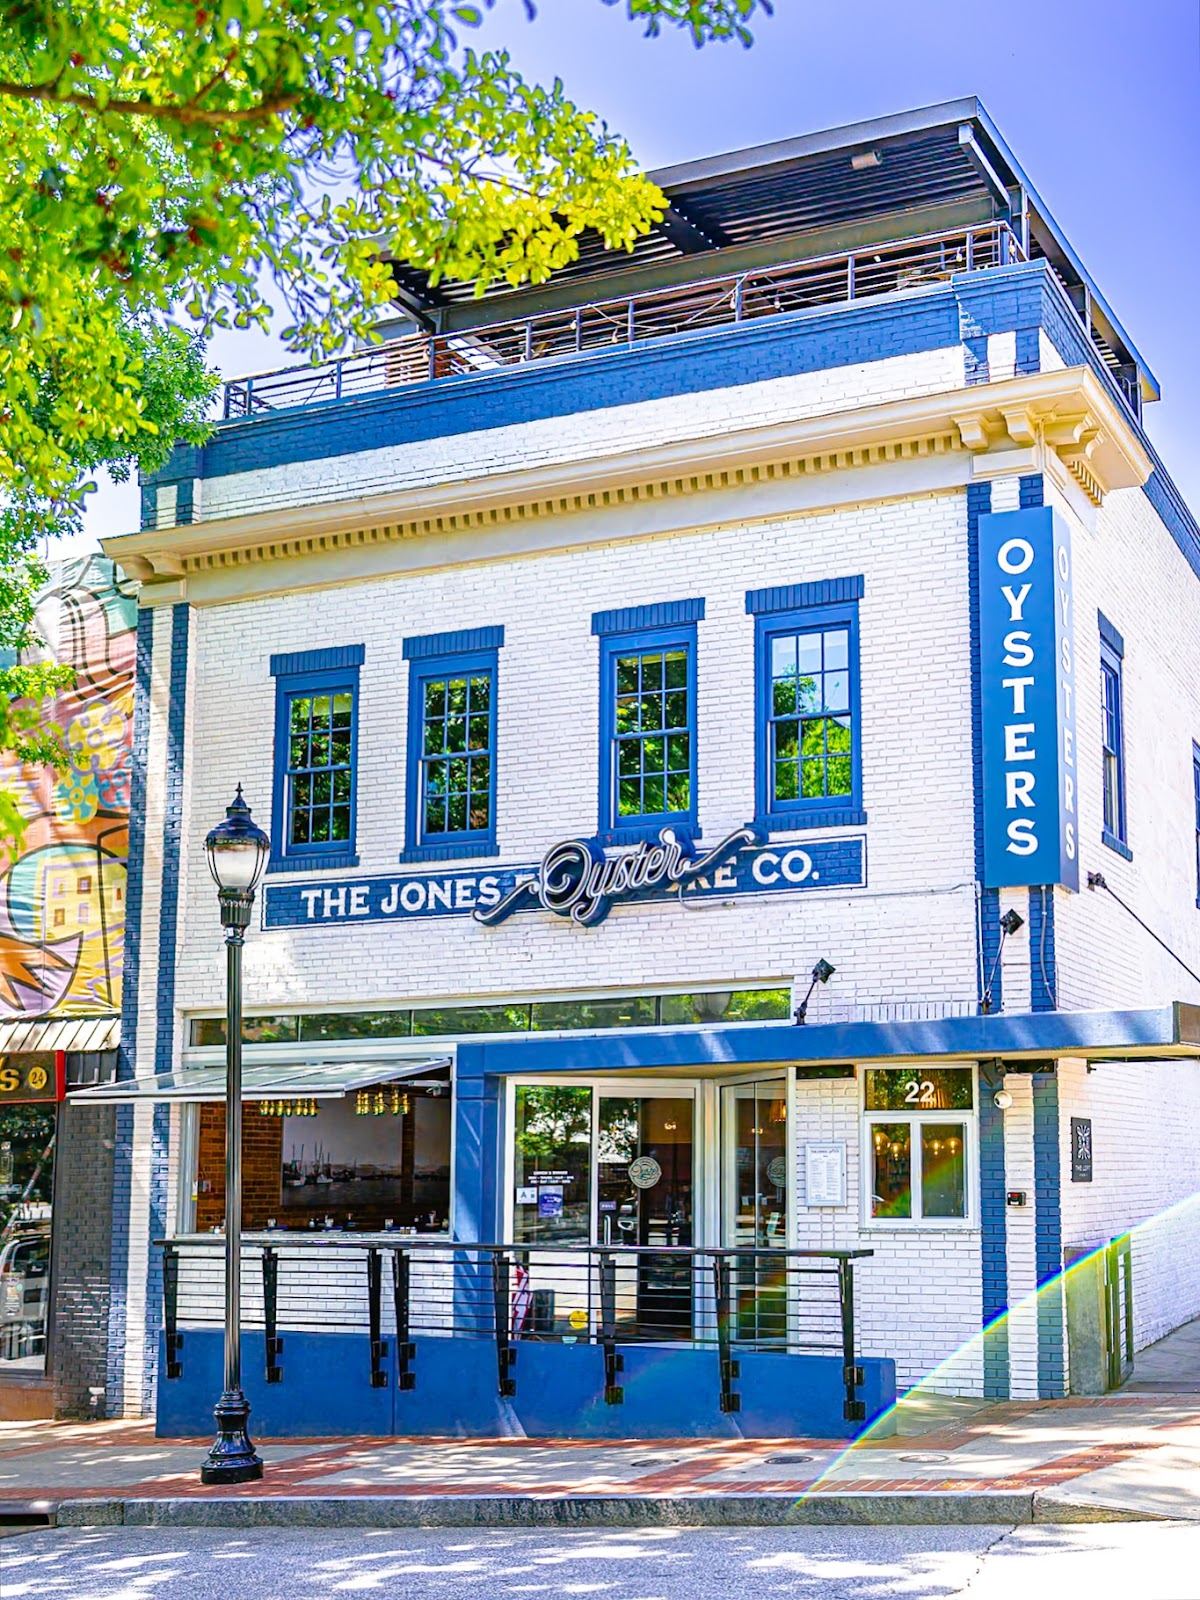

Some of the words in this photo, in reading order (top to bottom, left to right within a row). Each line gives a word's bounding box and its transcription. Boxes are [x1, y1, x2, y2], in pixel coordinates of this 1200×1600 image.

[997, 538, 1038, 856] OYSTERS
[1057, 544, 1077, 862] OYSTERS
[301, 885, 370, 919] THE
[381, 876, 500, 914] JONES
[752, 849, 820, 885] CO.
[538, 826, 757, 926] Oyster
[31, 1071, 44, 1085] 24
[905, 1081, 935, 1103] 22
